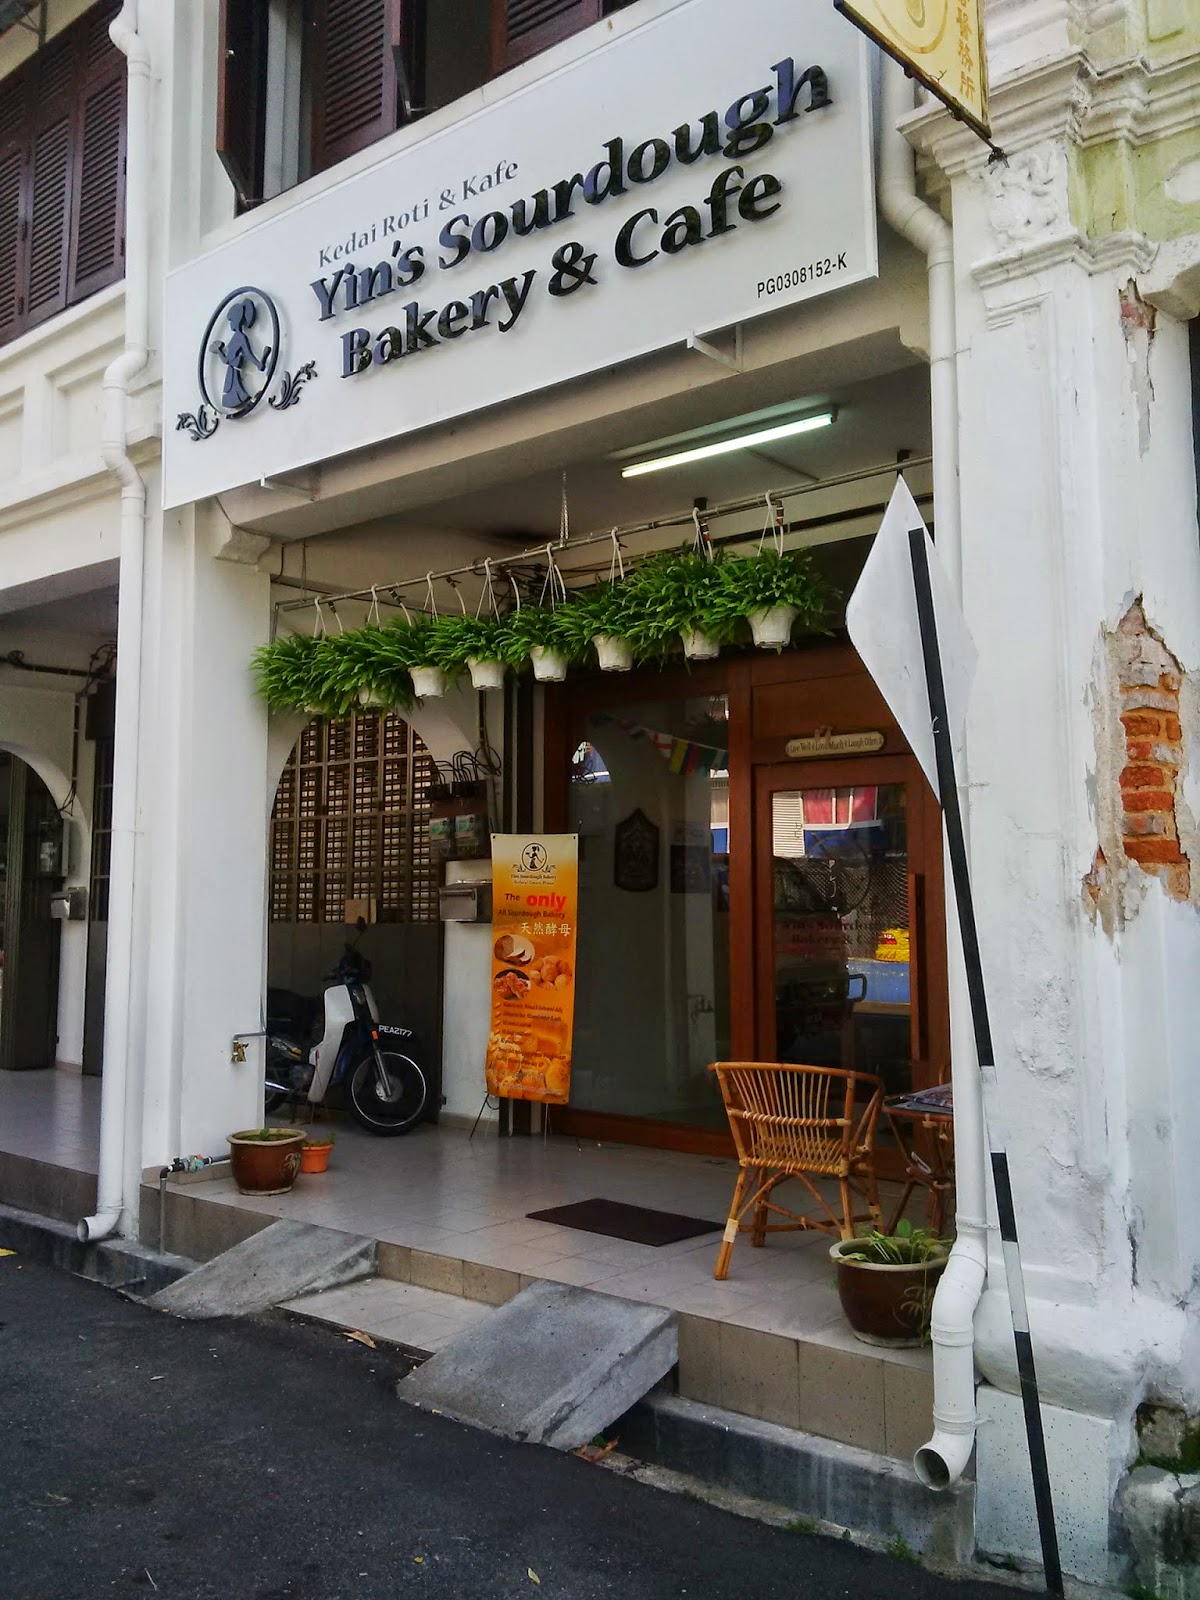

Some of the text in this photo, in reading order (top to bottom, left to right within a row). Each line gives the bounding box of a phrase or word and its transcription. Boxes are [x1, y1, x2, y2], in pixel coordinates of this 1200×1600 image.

[309, 56, 833, 322] Yin's Sourdough
[319, 160, 519, 268] Kedai Roti & Kafe
[340, 165, 783, 379] Bakery & Cafe
[756, 251, 848, 299] PG0308152-K
[505, 892, 567, 912] The only
[507, 909, 541, 919] Sourdough
[543, 910, 566, 919] Bakery
[521, 921, 571, 937] 天然酵母
[378, 1024, 413, 1038] PEA2177
